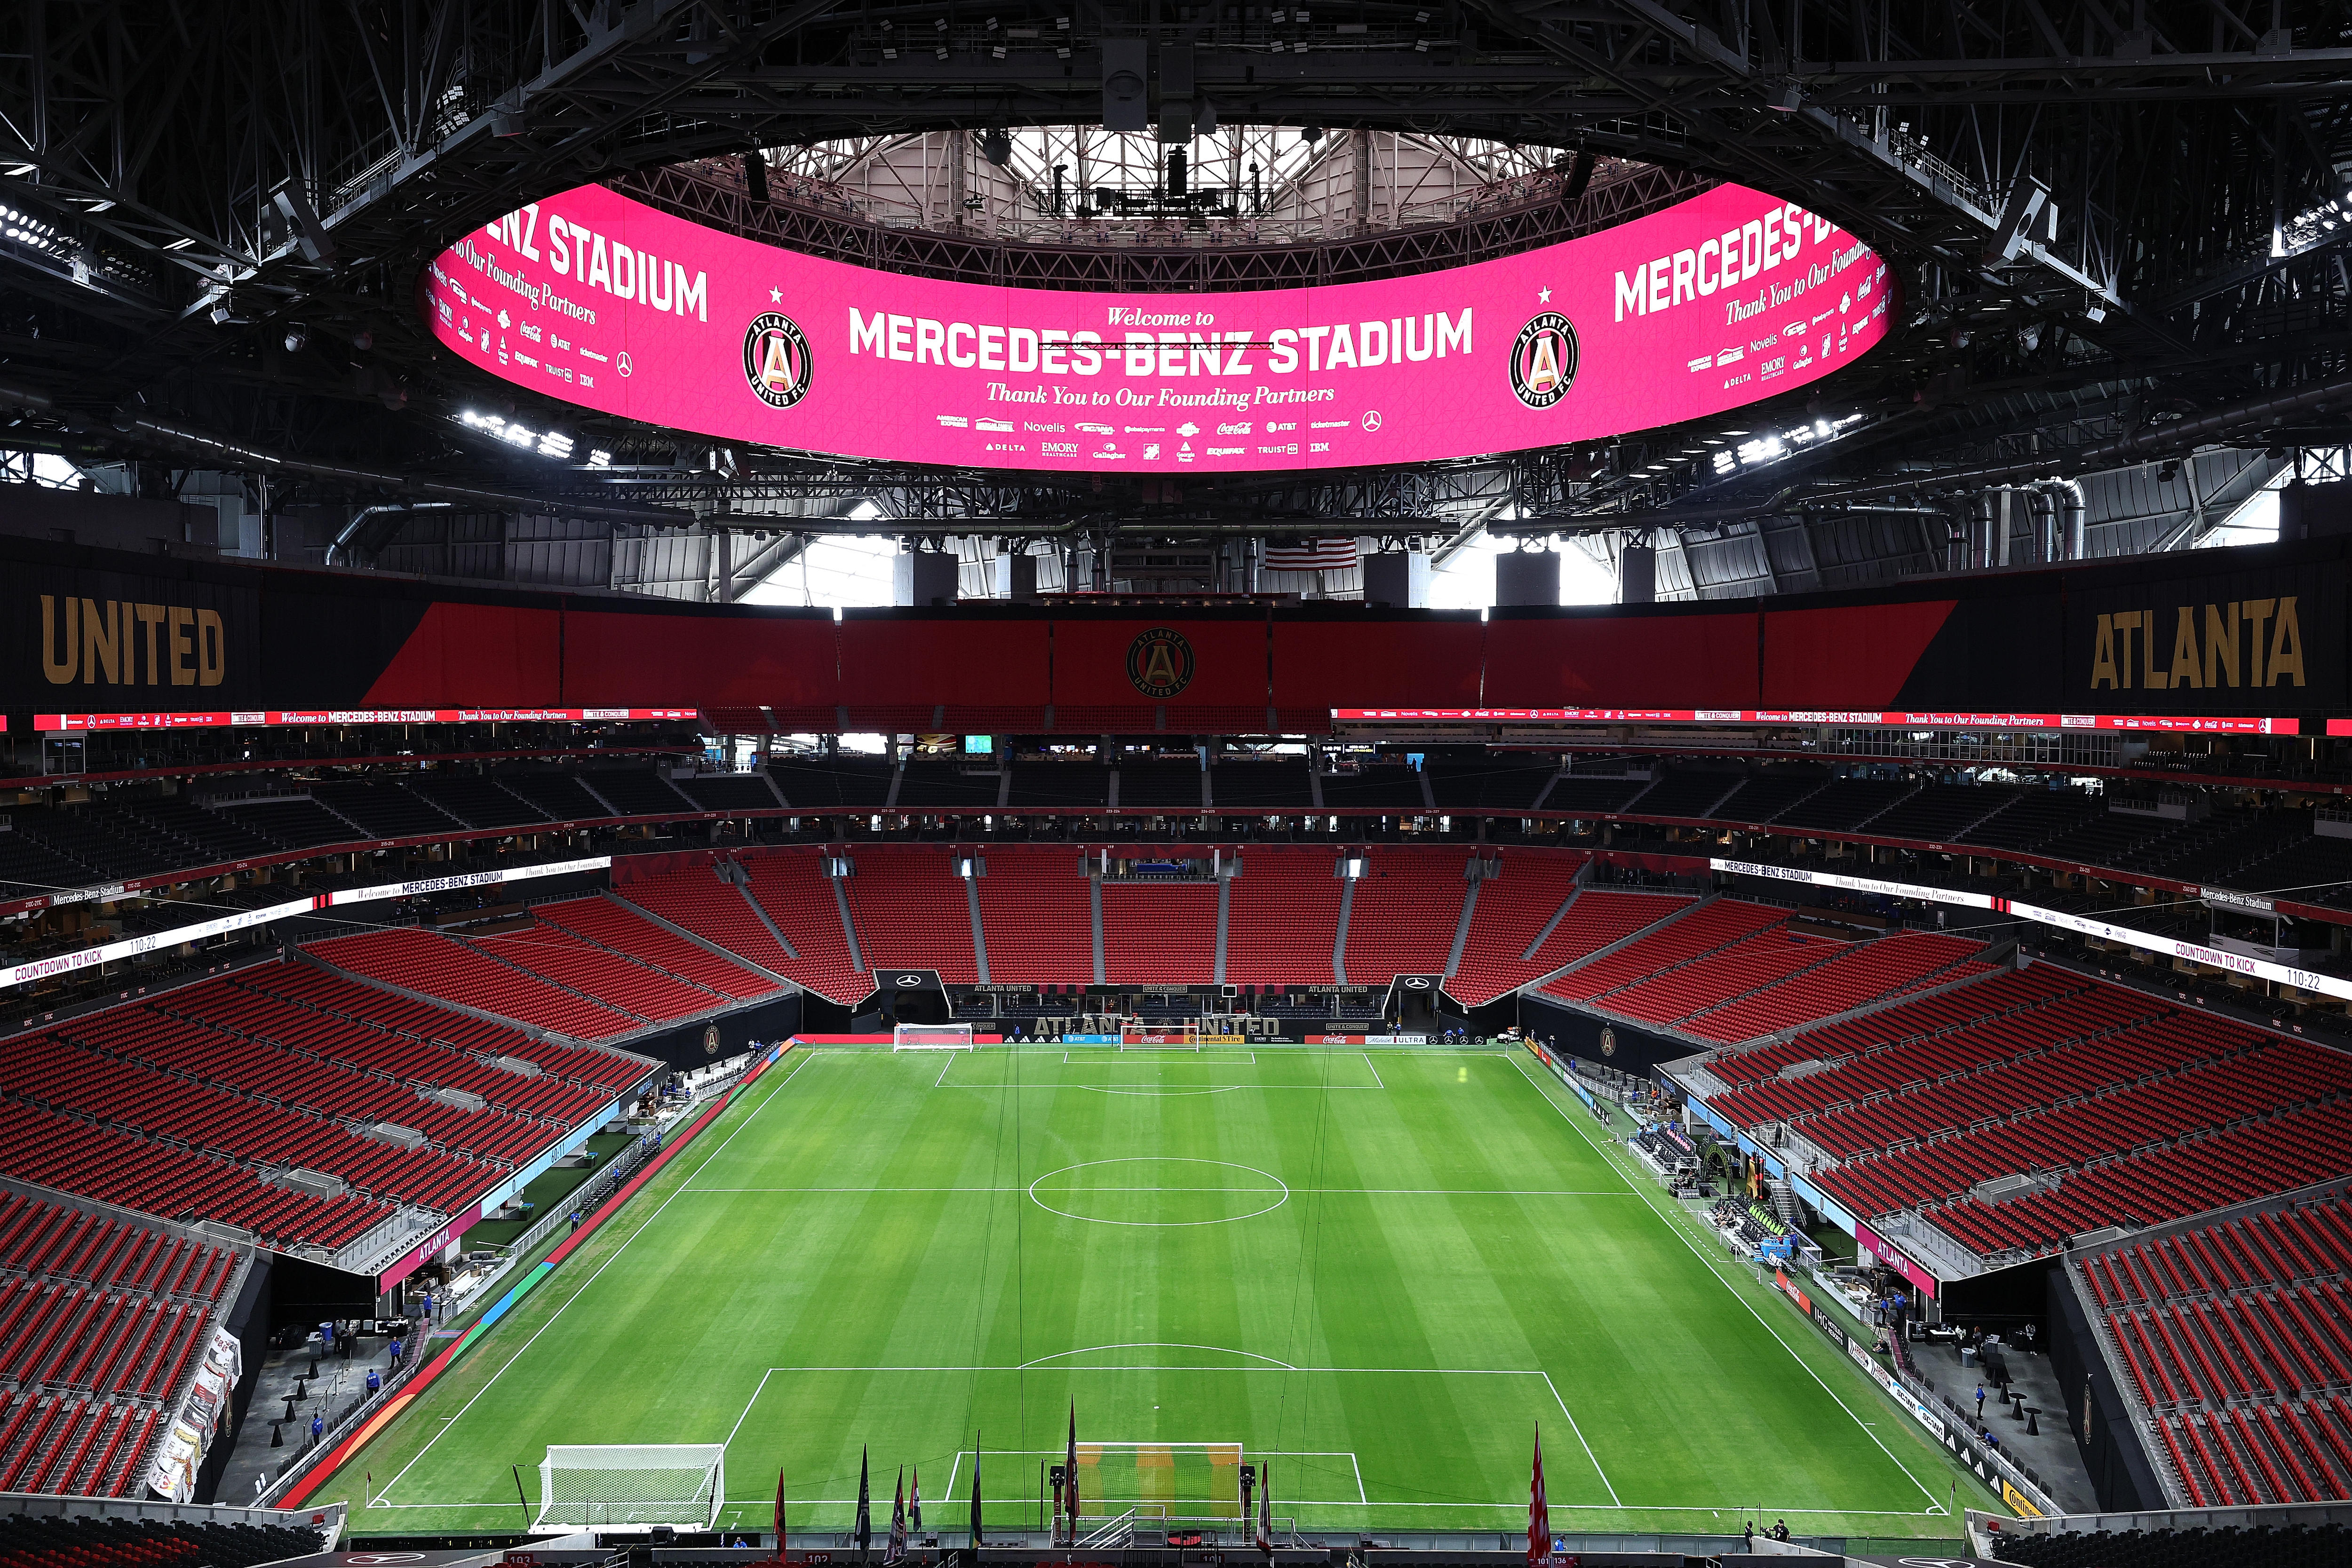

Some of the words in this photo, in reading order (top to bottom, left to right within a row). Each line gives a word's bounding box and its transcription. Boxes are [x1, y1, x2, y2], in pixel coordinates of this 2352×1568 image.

[549, 214, 708, 322] STADIUM
[466, 239, 486, 272] Our
[487, 252, 540, 311] Founding
[541, 282, 596, 325] Partners
[1725, 289, 1767, 326] Thank
[1769, 281, 1791, 309] You
[1794, 278, 1806, 297] to
[1808, 263, 1830, 289] Our
[439, 298, 453, 321] EMORY
[1107, 307, 1192, 326] Welcome
[1195, 311, 1215, 326] to
[753, 317, 802, 344] ATLANTA
[1520, 316, 1569, 344] ATLANTA
[557, 339, 572, 351] AT&T
[580, 347, 608, 363] ticketmaster
[849, 306, 1254, 377] MERCEDES-BENZ
[1268, 307, 1473, 374] STADIUM
[1750, 333, 1778, 353] Novelis
[515, 351, 539, 368] EQUIFAX
[545, 363, 564, 378] TRUIST
[580, 374, 595, 388] IBM
[1687, 355, 1712, 367] AMERICAN
[1731, 373, 1751, 386] DELTA
[1761, 355, 1786, 375] EMORY
[751, 375, 789, 406] UNITED
[791, 383, 805, 400] FC
[986, 382, 1048, 404] Thank
[1052, 386, 1088, 406] You
[1091, 390, 1111, 406] to
[1115, 388, 1154, 407] Our
[1158, 388, 1249, 412] Founding
[1253, 386, 1335, 405] Partners
[1517, 383, 1555, 406] UNITED
[1557, 375, 1571, 394] FC
[1024, 421, 1066, 433] Novelis
[1311, 420, 1350, 429] ticketmaster
[1042, 442, 1079, 453] EMORY
[1093, 452, 1126, 460] Gallagher
[1207, 447, 1246, 457] EQUIFAX
[1257, 445, 1286, 454] TRUIST
[1310, 443, 1329, 452] IBM
[40, 595, 224, 686] UNITED
[1137, 629, 1185, 647] ATLANTA
[2090, 596, 2305, 690] ATLANTA
[1135, 677, 1171, 695] UNITED
[1175, 677, 1187, 690] FC
[281, 712, 318, 724] Welcome
[318, 713, 326, 723] to
[328, 711, 400, 724] MERCEDES-BENZ
[400, 711, 436, 722] STADIUM
[458, 711, 479, 720] Thank
[479, 711, 493, 720] You
[500, 711, 514, 720] Our
[514, 710, 542, 721] Founding
[543, 710, 567, 720] Partners
[1756, 711, 1780, 721] Welcome
[1781, 713, 1788, 721] to
[1789, 711, 1848, 723] MERCEDES-BENZ
[1849, 712, 1882, 724] STADIUM
[1906, 713, 1929, 724] Thank
[1930, 714, 1944, 724] You
[1945, 715, 1953, 724] to
[1953, 715, 1969, 724] Our
[1970, 715, 2008, 726] Founding
[2009, 716, 2044, 725] Partners
[525, 867, 545, 877] Thank
[545, 866, 558, 875] You
[564, 863, 577, 872] Our
[577, 860, 604, 871] Founding
[1725, 861, 1780, 877] MERCEDES-BENZ
[1781, 868, 1812, 882] STADIUM
[53, 890, 99, 906] Mercedes-Benz
[100, 885, 124, 897] Stadium
[358, 887, 390, 899] Welcome
[402, 875, 469, 894] MERCEDES-BENZ
[470, 872, 503, 885] STADIUM
[1835, 876, 1856, 887] Thank
[1858, 879, 1871, 890] You
[1872, 882, 1878, 890] to
[1880, 882, 1895, 893] Our
[1896, 884, 1931, 898] Founding
[1931, 890, 1964, 903] Partners
[25, 900, 42, 908] 210C-211C
[2201, 888, 2244, 905] Mercedes-Benz
[2245, 896, 2272, 910] Stadium
[16, 957, 69, 981] COUNTDOWN
[72, 954, 82, 966] TO
[85, 949, 102, 964] KICK
[131, 936, 156, 953] 110:22
[2176, 943, 2222, 965] COUNTDOWN
[2225, 955, 2234, 968] TO
[2237, 958, 2255, 973] KICK
[2288, 969, 2320, 990] 110:22
[1184, 1018, 1279, 1035] UNITED
[551, 1142, 565, 1163] 60:11
[419, 1228, 450, 1262] ATLANTA
[1877, 1241, 1908, 1275] ATLANTA
[1815, 1306, 1828, 1330] IHG
[1828, 1320, 1841, 1335] HOTELS
[1828, 1328, 1843, 1345] RESORTS
[1854, 1345, 1866, 1362] ARROW
[1875, 1366, 1888, 1382] ARROW
[510, 1555, 530, 1565] 103
[808, 1555, 827, 1563] 102
